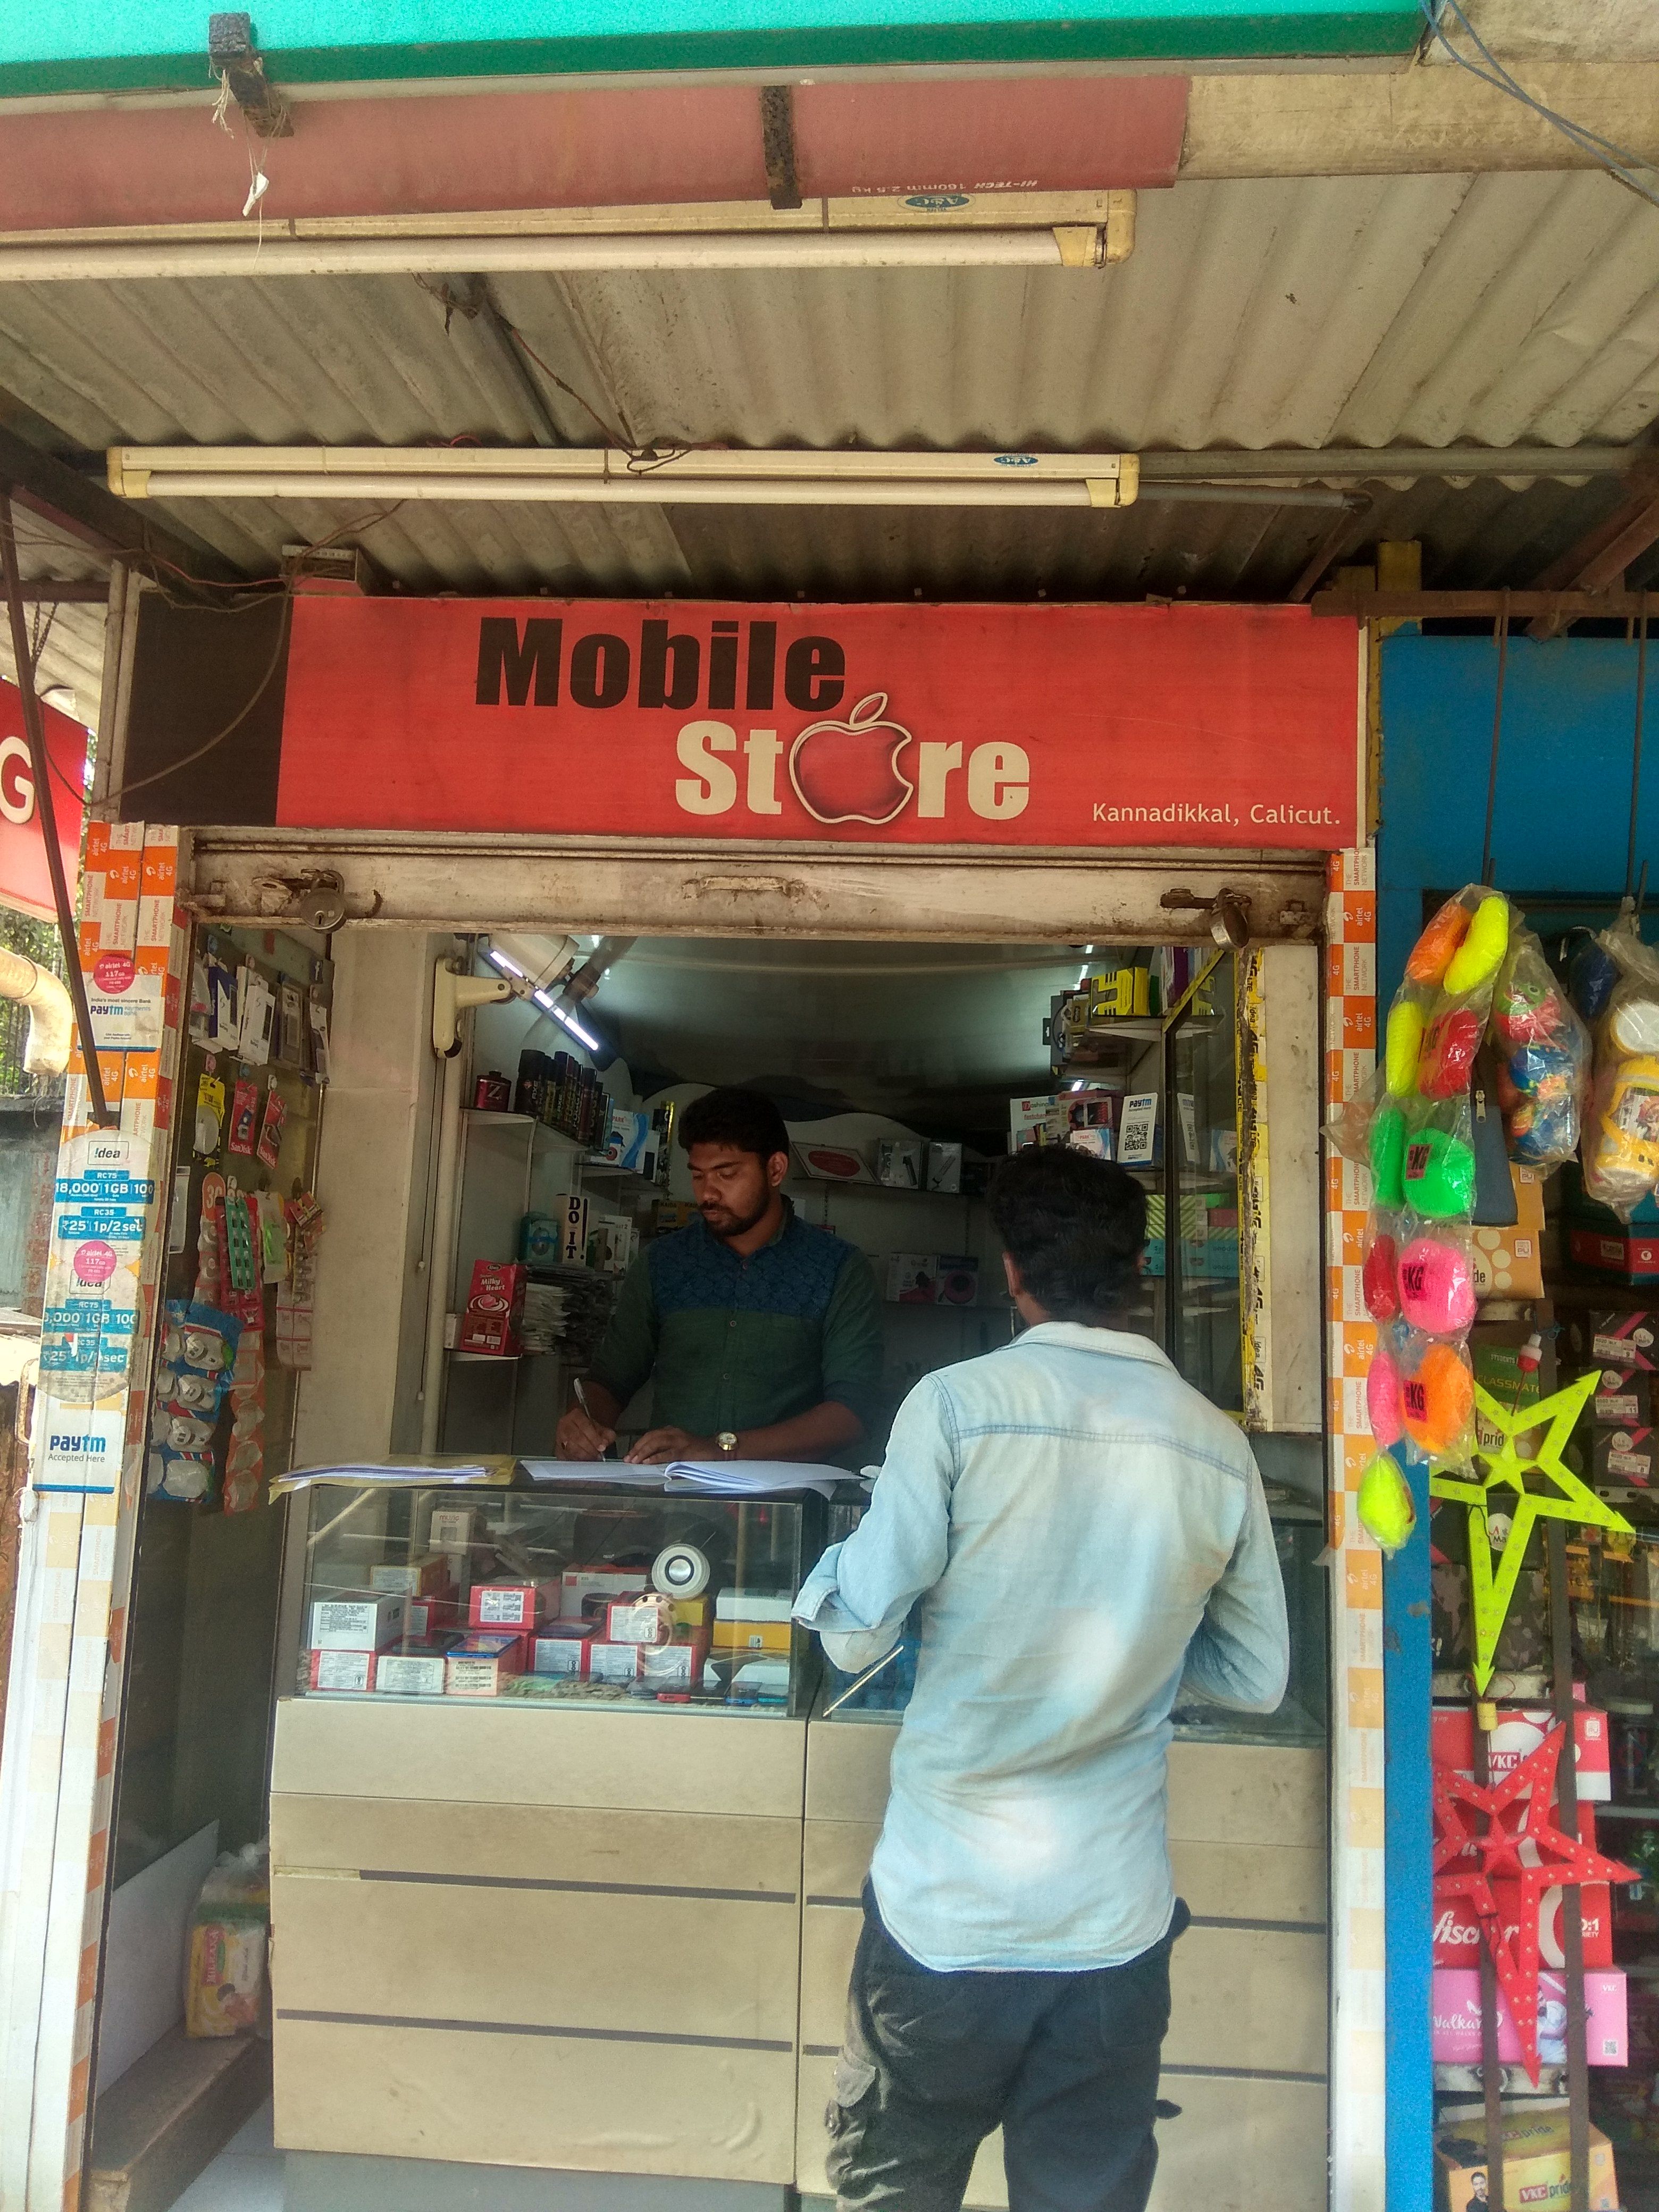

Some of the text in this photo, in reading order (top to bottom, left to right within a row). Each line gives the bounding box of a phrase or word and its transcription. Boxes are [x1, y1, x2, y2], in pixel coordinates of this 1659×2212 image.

[475, 617, 845, 712] Mobile
[1092, 802, 1340, 828] Kannadikkal, Calicut.
[100, 843, 108, 853] 4G
[166, 866, 173, 877] 4G
[1333, 860, 1340, 873] 4G
[130, 870, 137, 880] 4G
[1365, 910, 1371, 923] 4G
[113, 903, 122, 945] SMARTPHONE
[83, 937, 92, 957] airtel
[92, 941, 99, 953] 4G
[1333, 964, 1340, 976] 4G
[1365, 1015, 1371, 1028] 4G
[113, 1071, 119, 1082] 4G
[149, 1068, 155, 1079] 4G
[1333, 1070, 1339, 1083] 4G
[67, 1077, 77, 1121] SMARTPHONE
[230, 1142, 252, 1155] SanDisk
[259, 1146, 276, 1168] SanDisk
[1333, 1178, 1339, 1190] 4G
[1367, 1343, 1374, 1356] 4G
[1490, 1353, 1515, 1364] STUDENTS
[1334, 1400, 1340, 1412] 4G
[1484, 1432, 1504, 1446] prid
[48, 1454, 84, 1463] Accepted
[1335, 1514, 1341, 1527] 4G
[93, 1529, 101, 1576] SMARTPHONE
[1371, 1573, 1377, 1586] 4G
[1521, 2186, 1547, 2201] VKC
